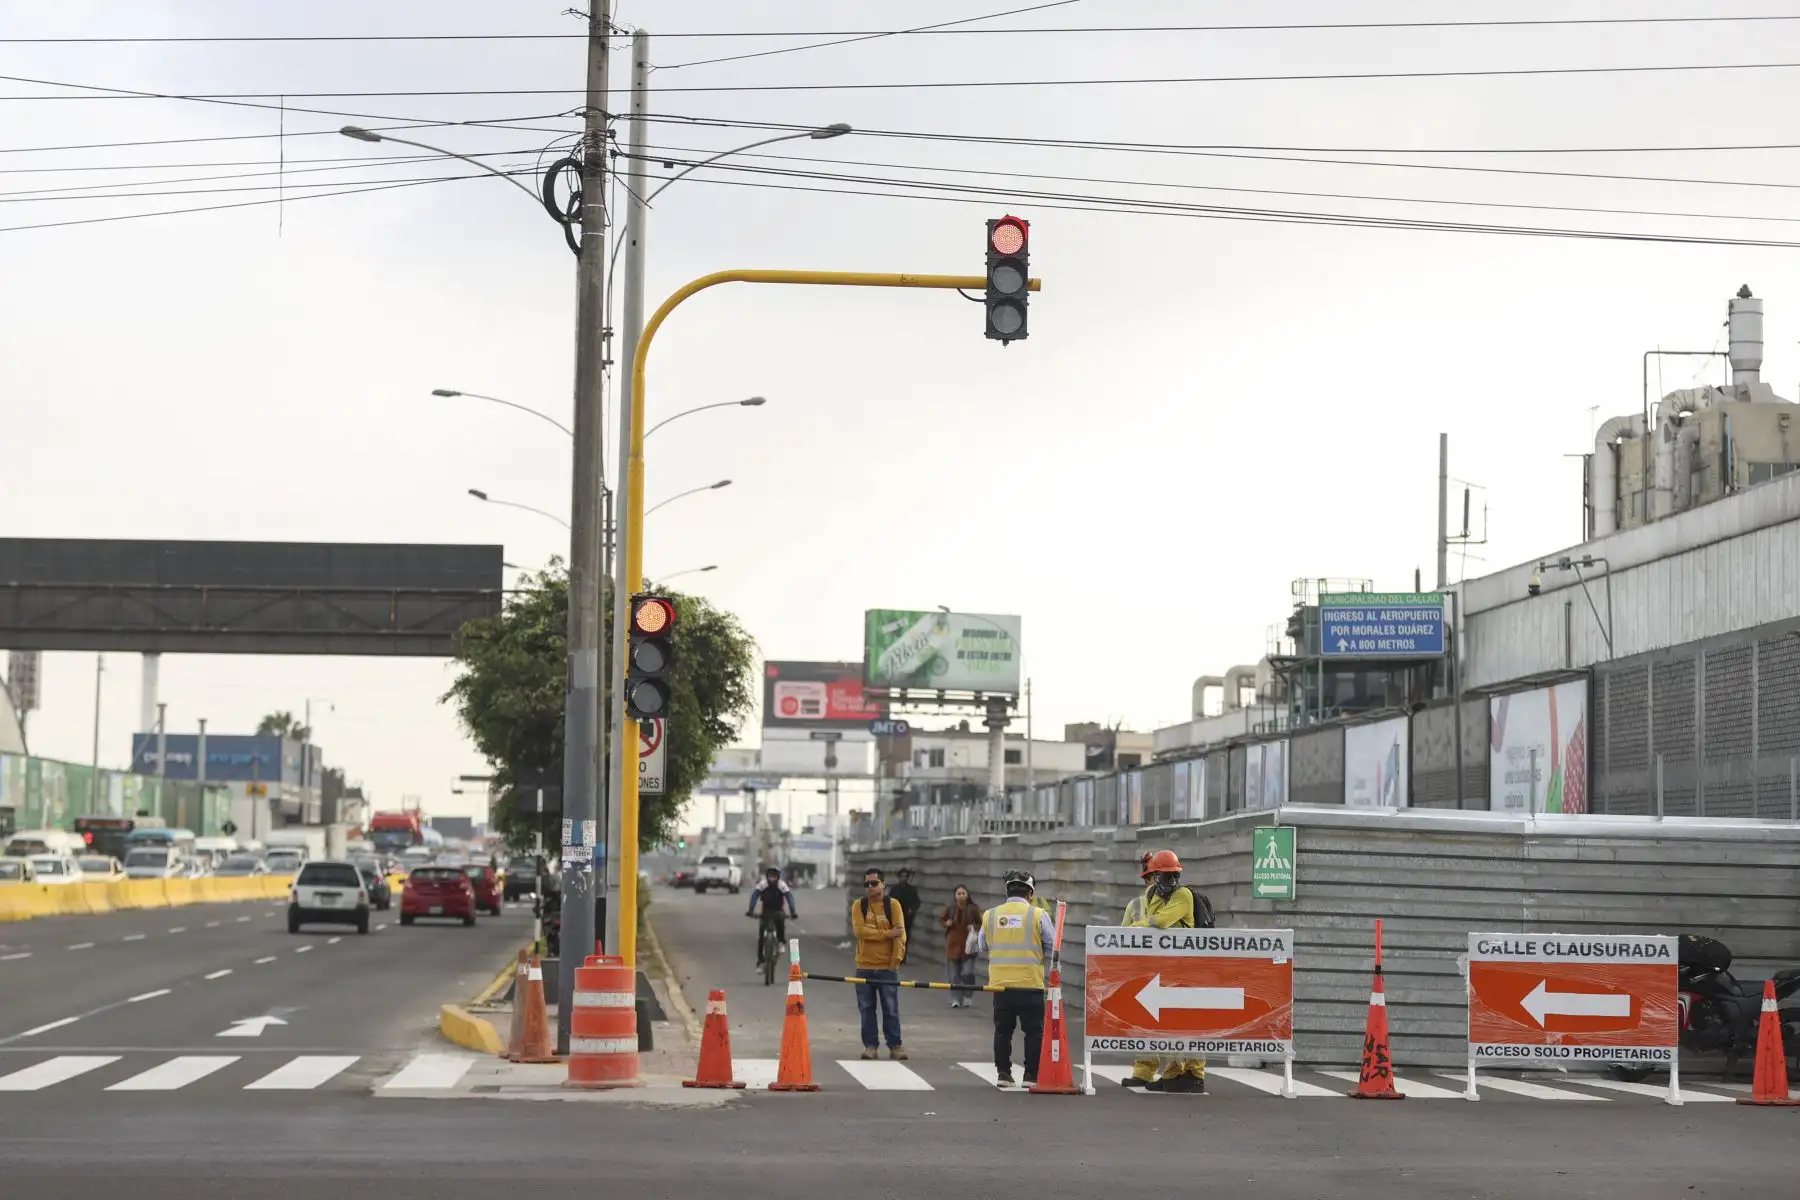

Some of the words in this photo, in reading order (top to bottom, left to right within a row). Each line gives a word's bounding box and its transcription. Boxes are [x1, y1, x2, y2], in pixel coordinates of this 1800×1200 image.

[1324, 595, 1387, 605] MUNICIPALIDAD
[1406, 594, 1440, 604] CALLAO
[1324, 611, 1364, 621] INGRESO
[1366, 611, 1378, 621] AL
[1380, 610, 1440, 621] AEROPUERTO
[1331, 625, 1350, 636] POR
[1352, 625, 1396, 636] MORALES
[1350, 640, 1357, 650] A
[1359, 640, 1376, 650] 800
[1378, 639, 1416, 650] METROS
[871, 722, 895, 733] JMT
[1094, 934, 1153, 949] CALLE
[1158, 935, 1285, 952] CLAUSURADA
[1477, 940, 1537, 956] CALLE
[1542, 941, 1671, 958] CLAUSURADA
[1091, 1039, 1146, 1051] ACCESO
[1149, 1040, 1185, 1052] SOLO
[1188, 1041, 1285, 1053] PROPIETARIOS
[1475, 1046, 1531, 1058] ACCESO
[1534, 1047, 1570, 1059] SOLO
[1574, 1048, 1672, 1060] PROPIETARIOS
